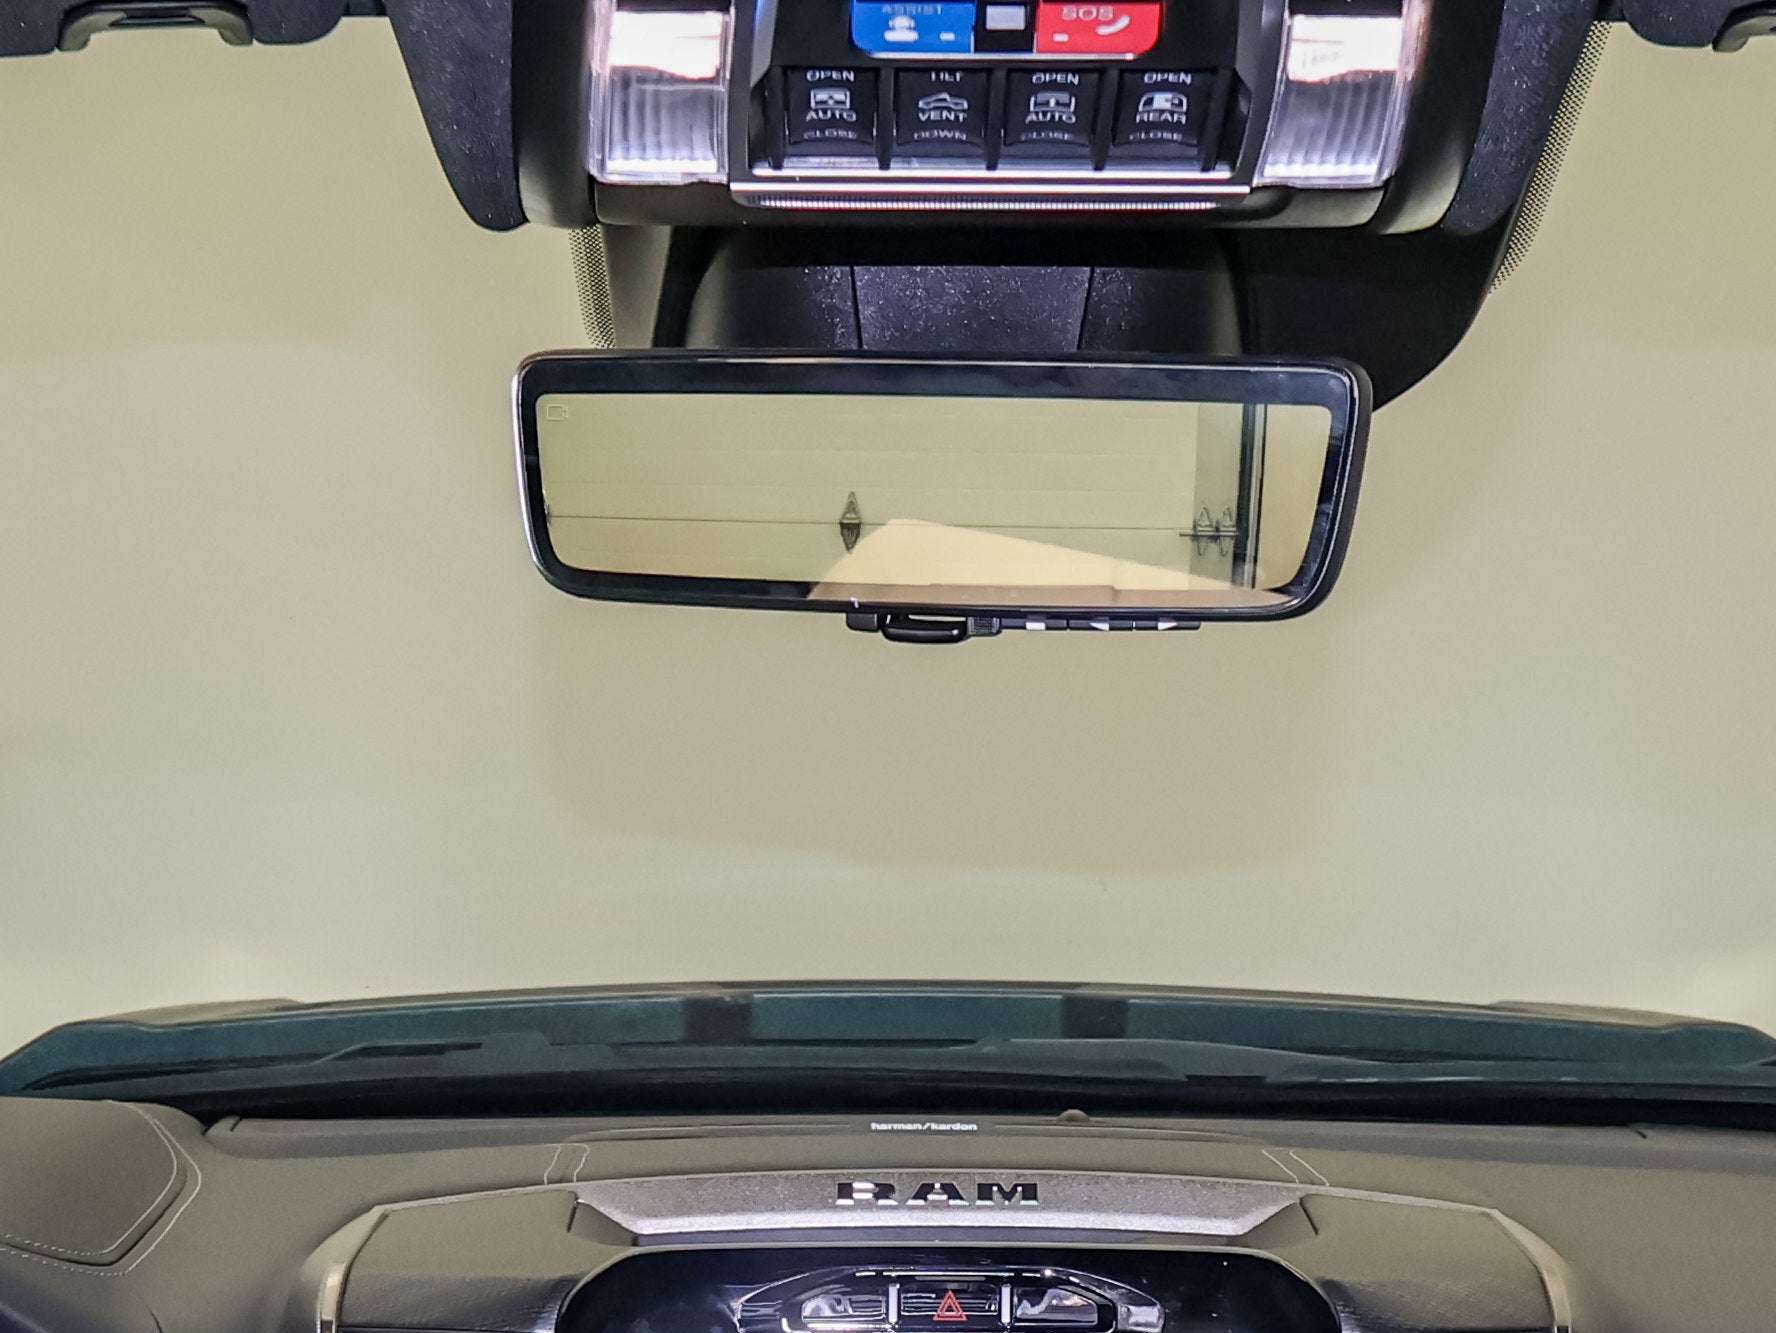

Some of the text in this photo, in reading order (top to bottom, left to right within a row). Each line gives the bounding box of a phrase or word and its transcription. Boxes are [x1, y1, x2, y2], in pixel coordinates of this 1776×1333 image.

[1061, 5, 1114, 20] SOS
[806, 70, 855, 82] OPEN
[1032, 72, 1080, 85] OPEN
[1144, 72, 1192, 85] OPEN
[805, 109, 856, 122] AUTO
[918, 110, 967, 122] VENT
[1025, 111, 1076, 124] AUTO
[870, 1122, 978, 1131] harman/kardon
[835, 1182, 1040, 1206] RAM
